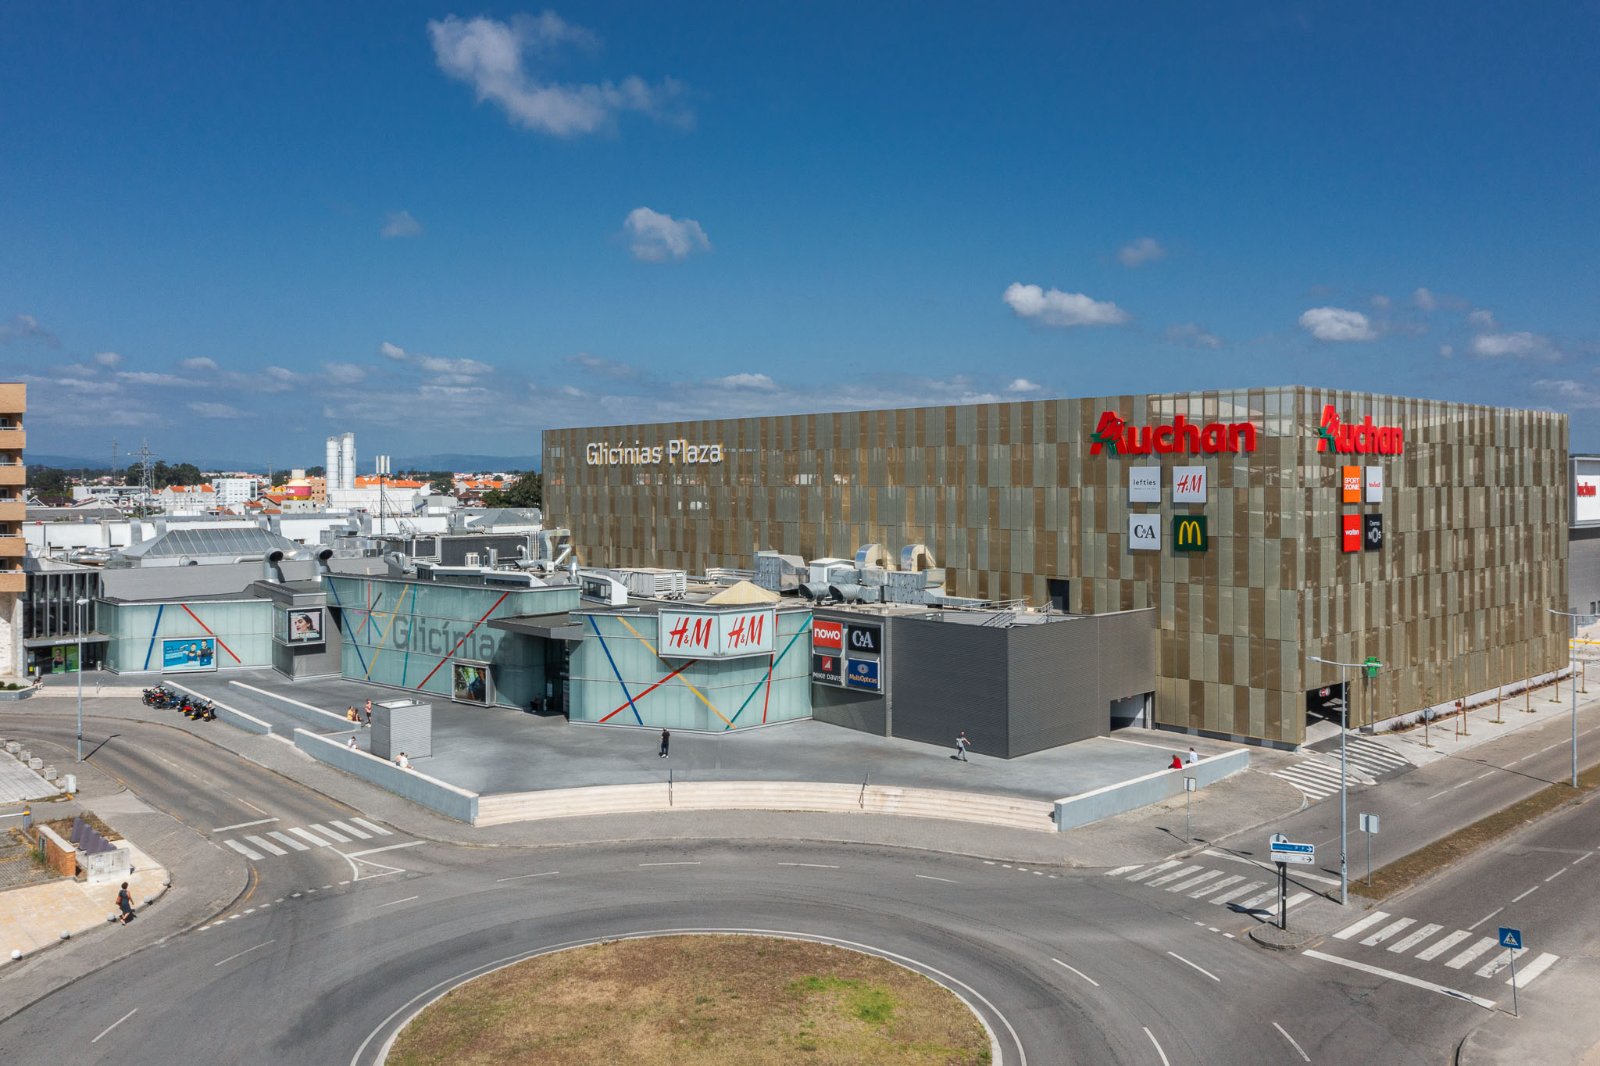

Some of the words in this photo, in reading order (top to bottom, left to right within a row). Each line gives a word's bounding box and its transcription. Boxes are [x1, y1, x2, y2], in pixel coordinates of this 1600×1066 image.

[1089, 411, 1257, 455] Auchan
[1316, 404, 1404, 455] Auchan
[586, 440, 661, 465] Glicínias
[668, 437, 723, 463] Plaza
[1176, 474, 1202, 494] H&M
[1134, 524, 1156, 539] C&A
[1368, 527, 1382, 543] NOS
[669, 616, 713, 650] H&M
[728, 614, 764, 649] H&M
[814, 628, 841, 640] nowo
[852, 630, 875, 649] C&A
